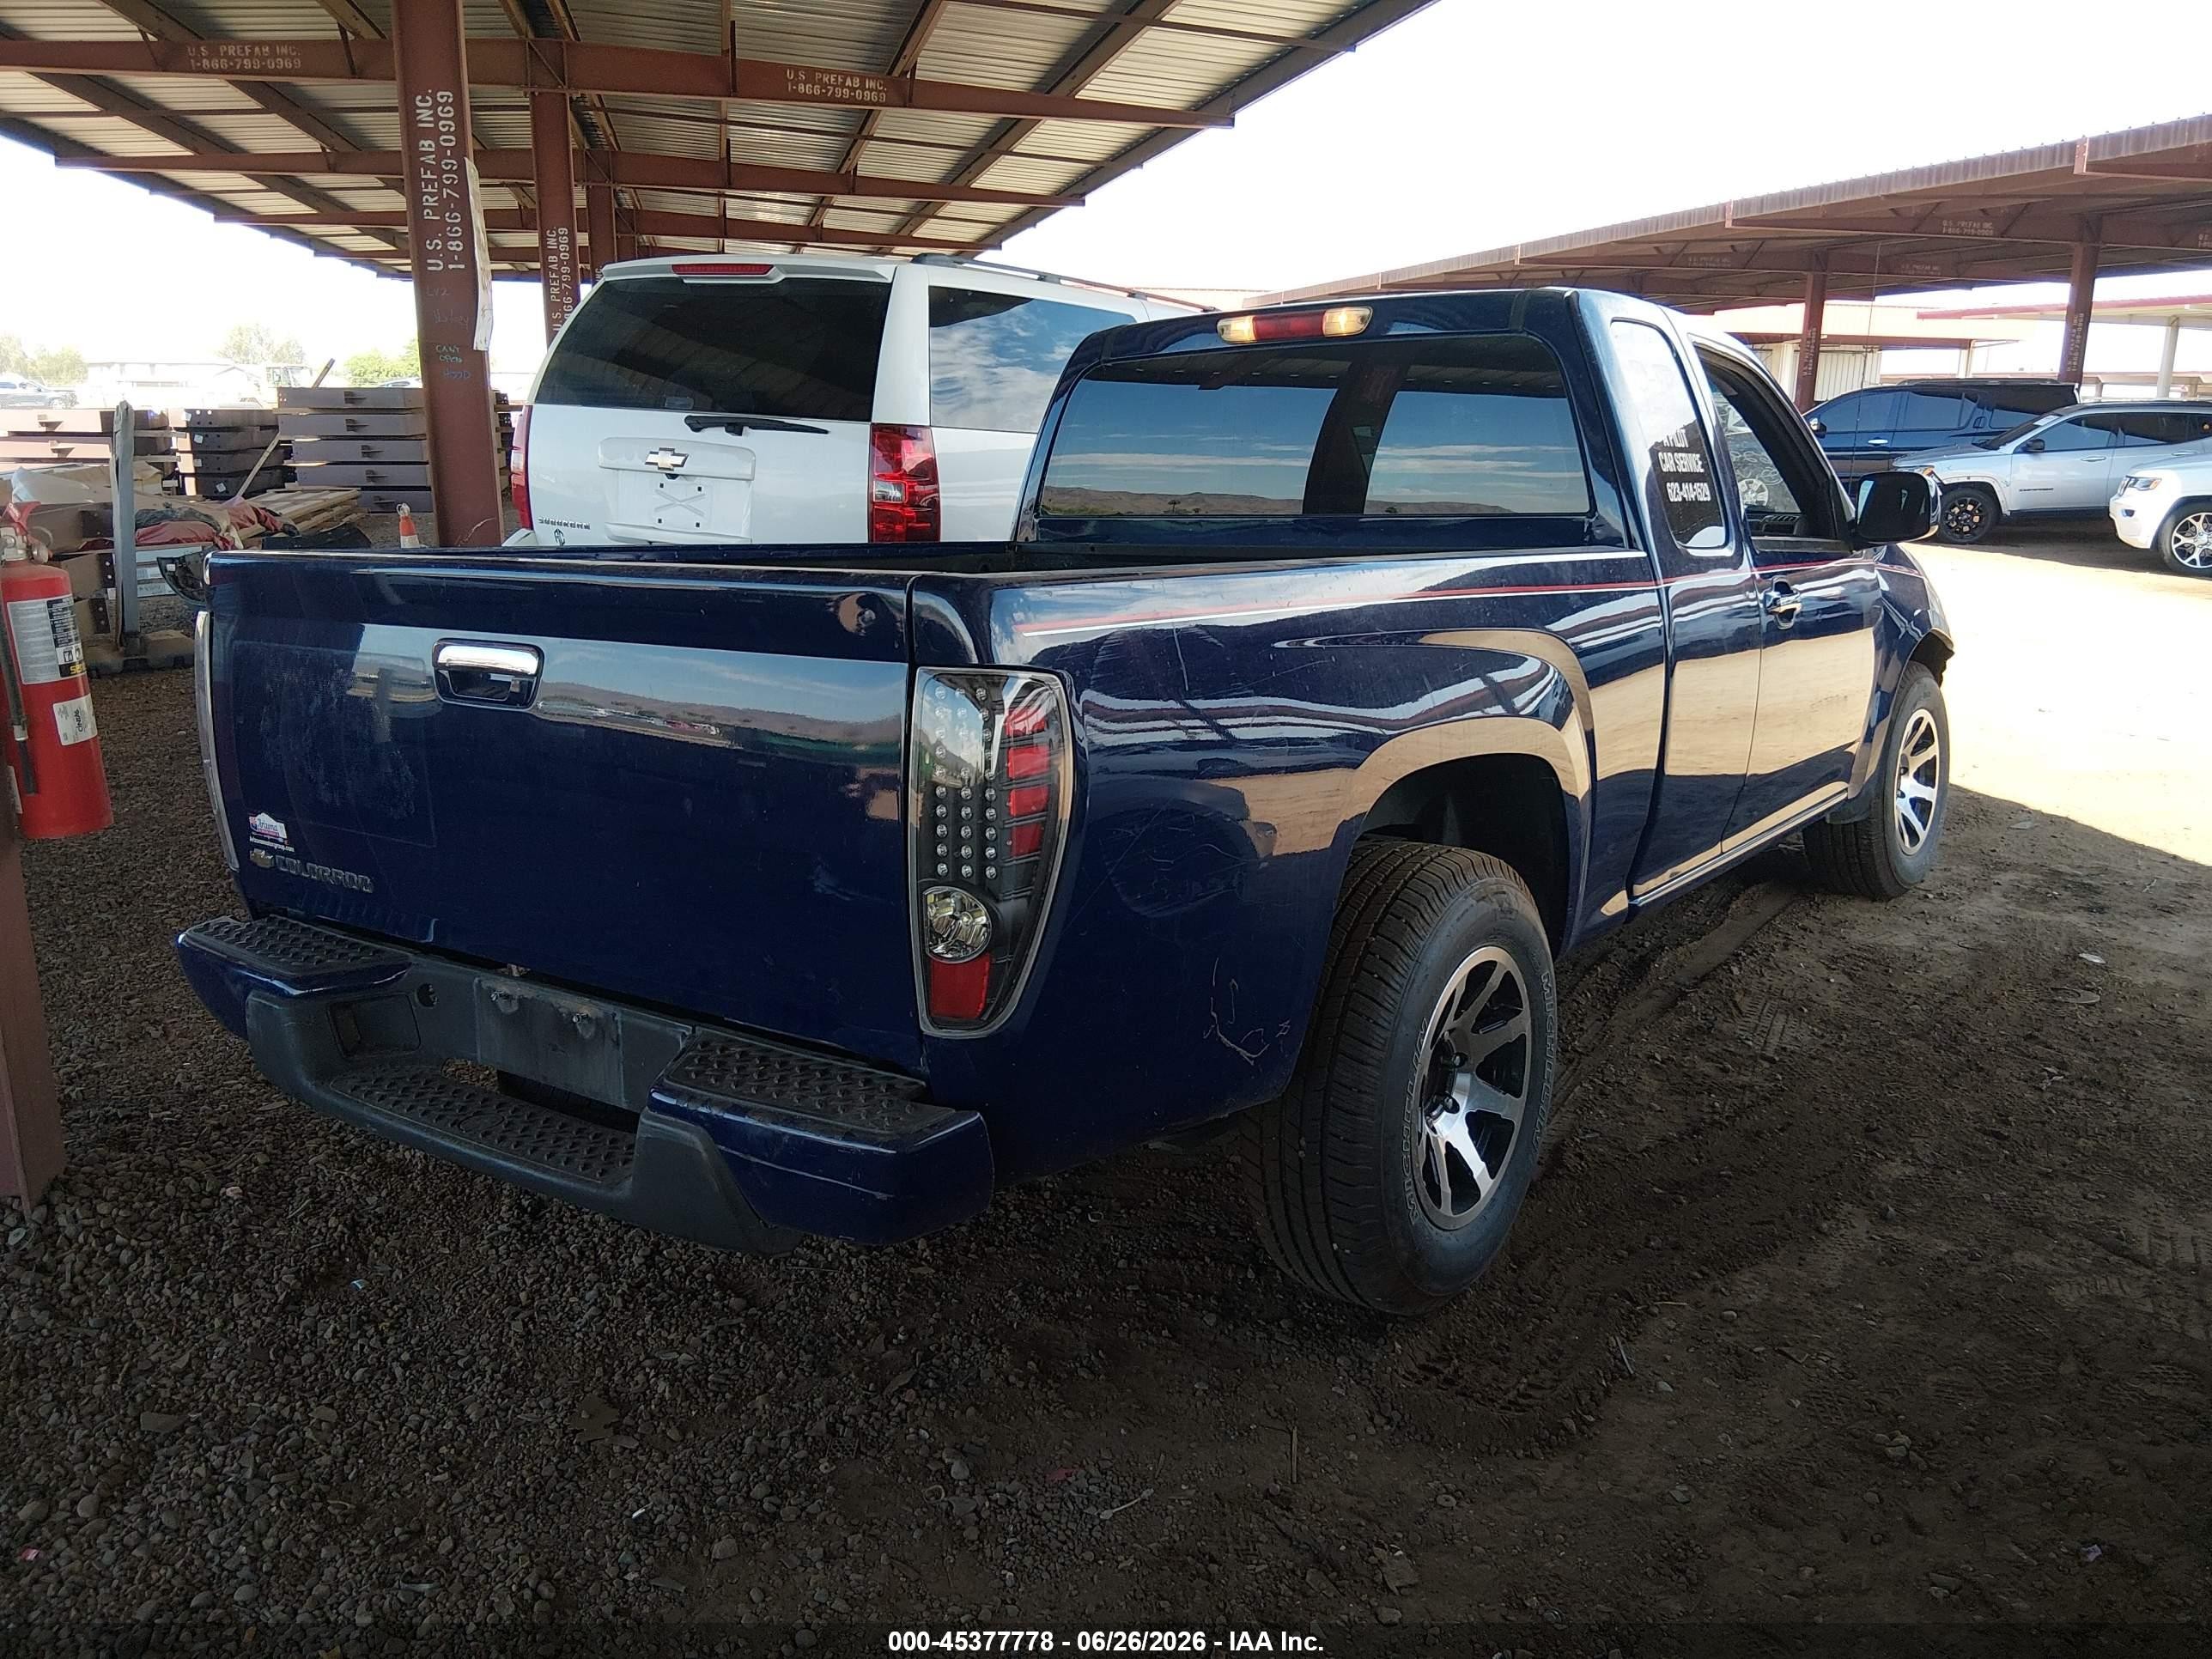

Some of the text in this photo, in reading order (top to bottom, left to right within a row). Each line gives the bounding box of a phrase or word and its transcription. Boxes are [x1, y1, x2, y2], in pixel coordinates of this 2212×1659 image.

[219, 44, 270, 57] PREFAB
[276, 44, 301, 57] INC.
[190, 58, 301, 70] 1-866-799-0969
[787, 82, 887, 103] 1-866-799-0969
[815, 72, 860, 88] PREFAB
[865, 77, 887, 92] INC.
[415, 89, 444, 271] U.S. PREFAB INC.
[435, 91, 465, 270] 1-866-799-0969
[546, 226, 558, 249] INC.
[548, 255, 561, 302] PREFAB
[1658, 452, 1705, 473] CAR SERVICE
[275, 854, 374, 894] COLORADO
[1533, 970, 1558, 1150] MICHELIN
